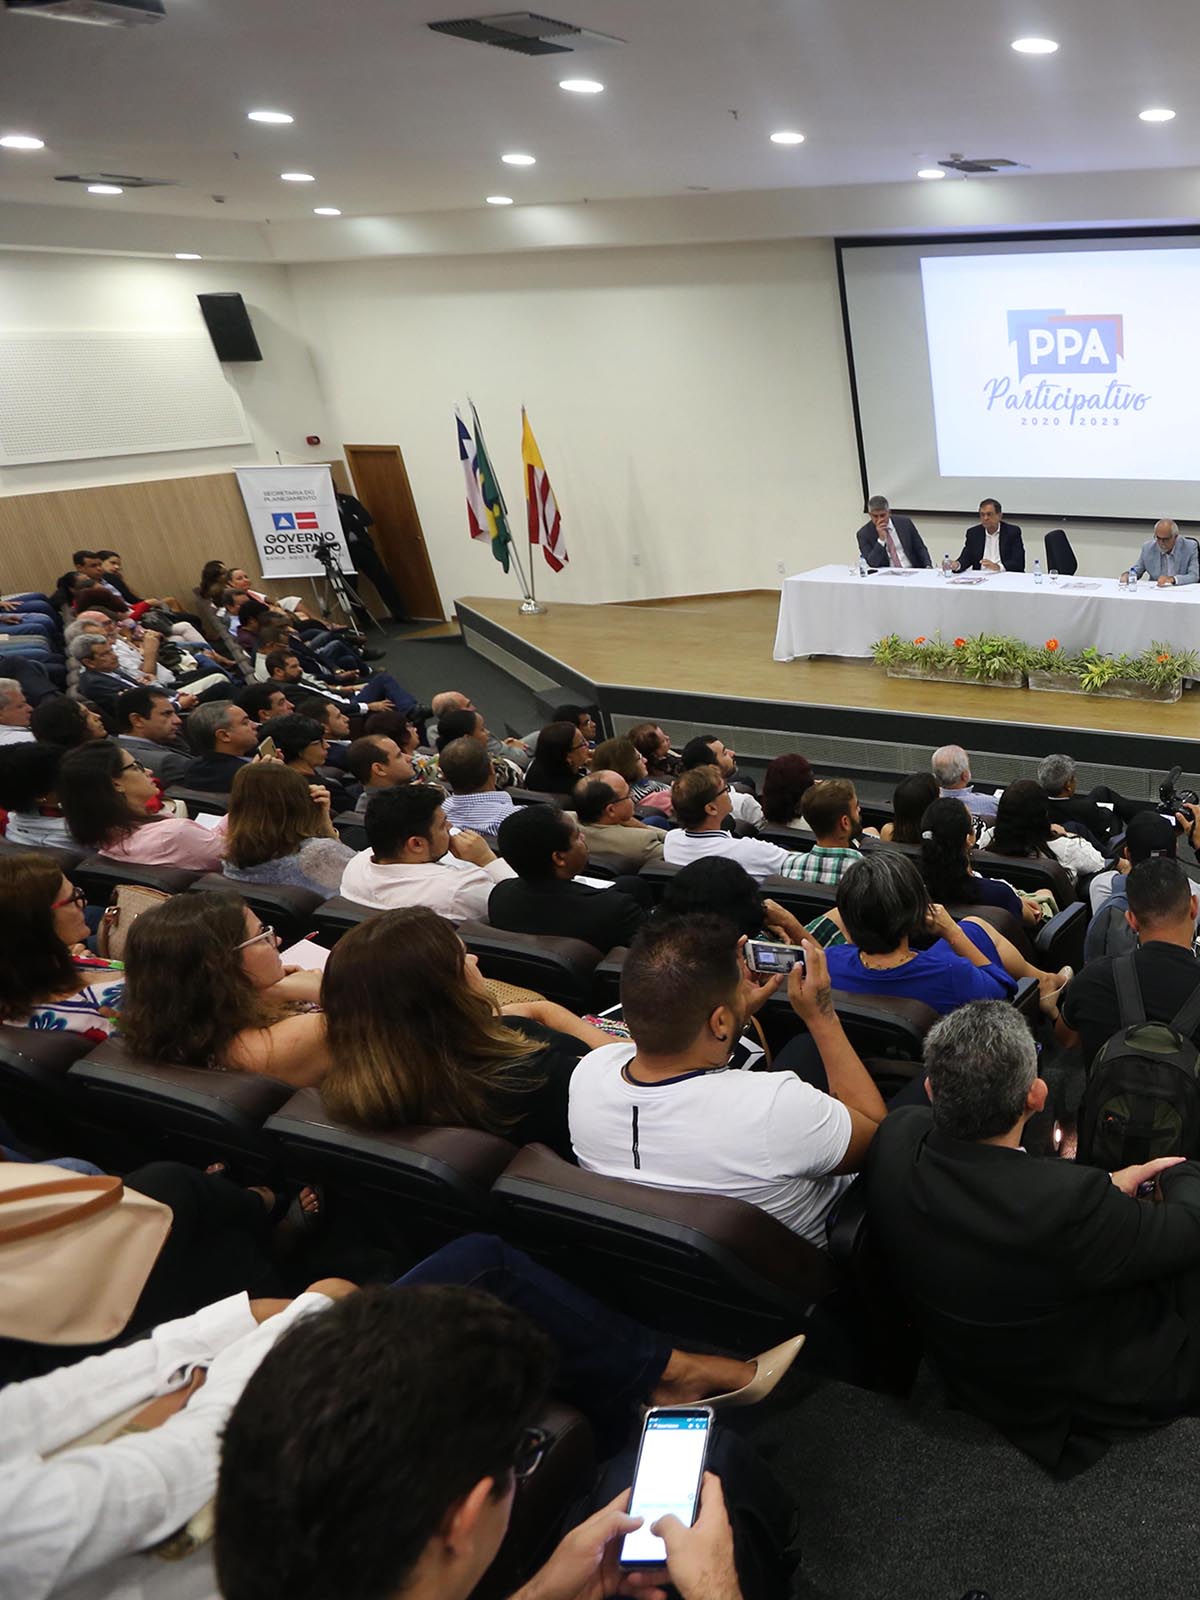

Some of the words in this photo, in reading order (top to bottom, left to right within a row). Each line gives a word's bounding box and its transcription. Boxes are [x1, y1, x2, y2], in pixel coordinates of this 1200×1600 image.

[1028, 327, 1110, 365] PPA
[983, 376, 1152, 426] Participativo
[1021, 417, 1060, 426] 2020
[1080, 417, 1120, 426] 2023
[265, 531, 336, 544] GOVERNO
[263, 545, 286, 555] DO
[287, 543, 342, 555] ESTAO
